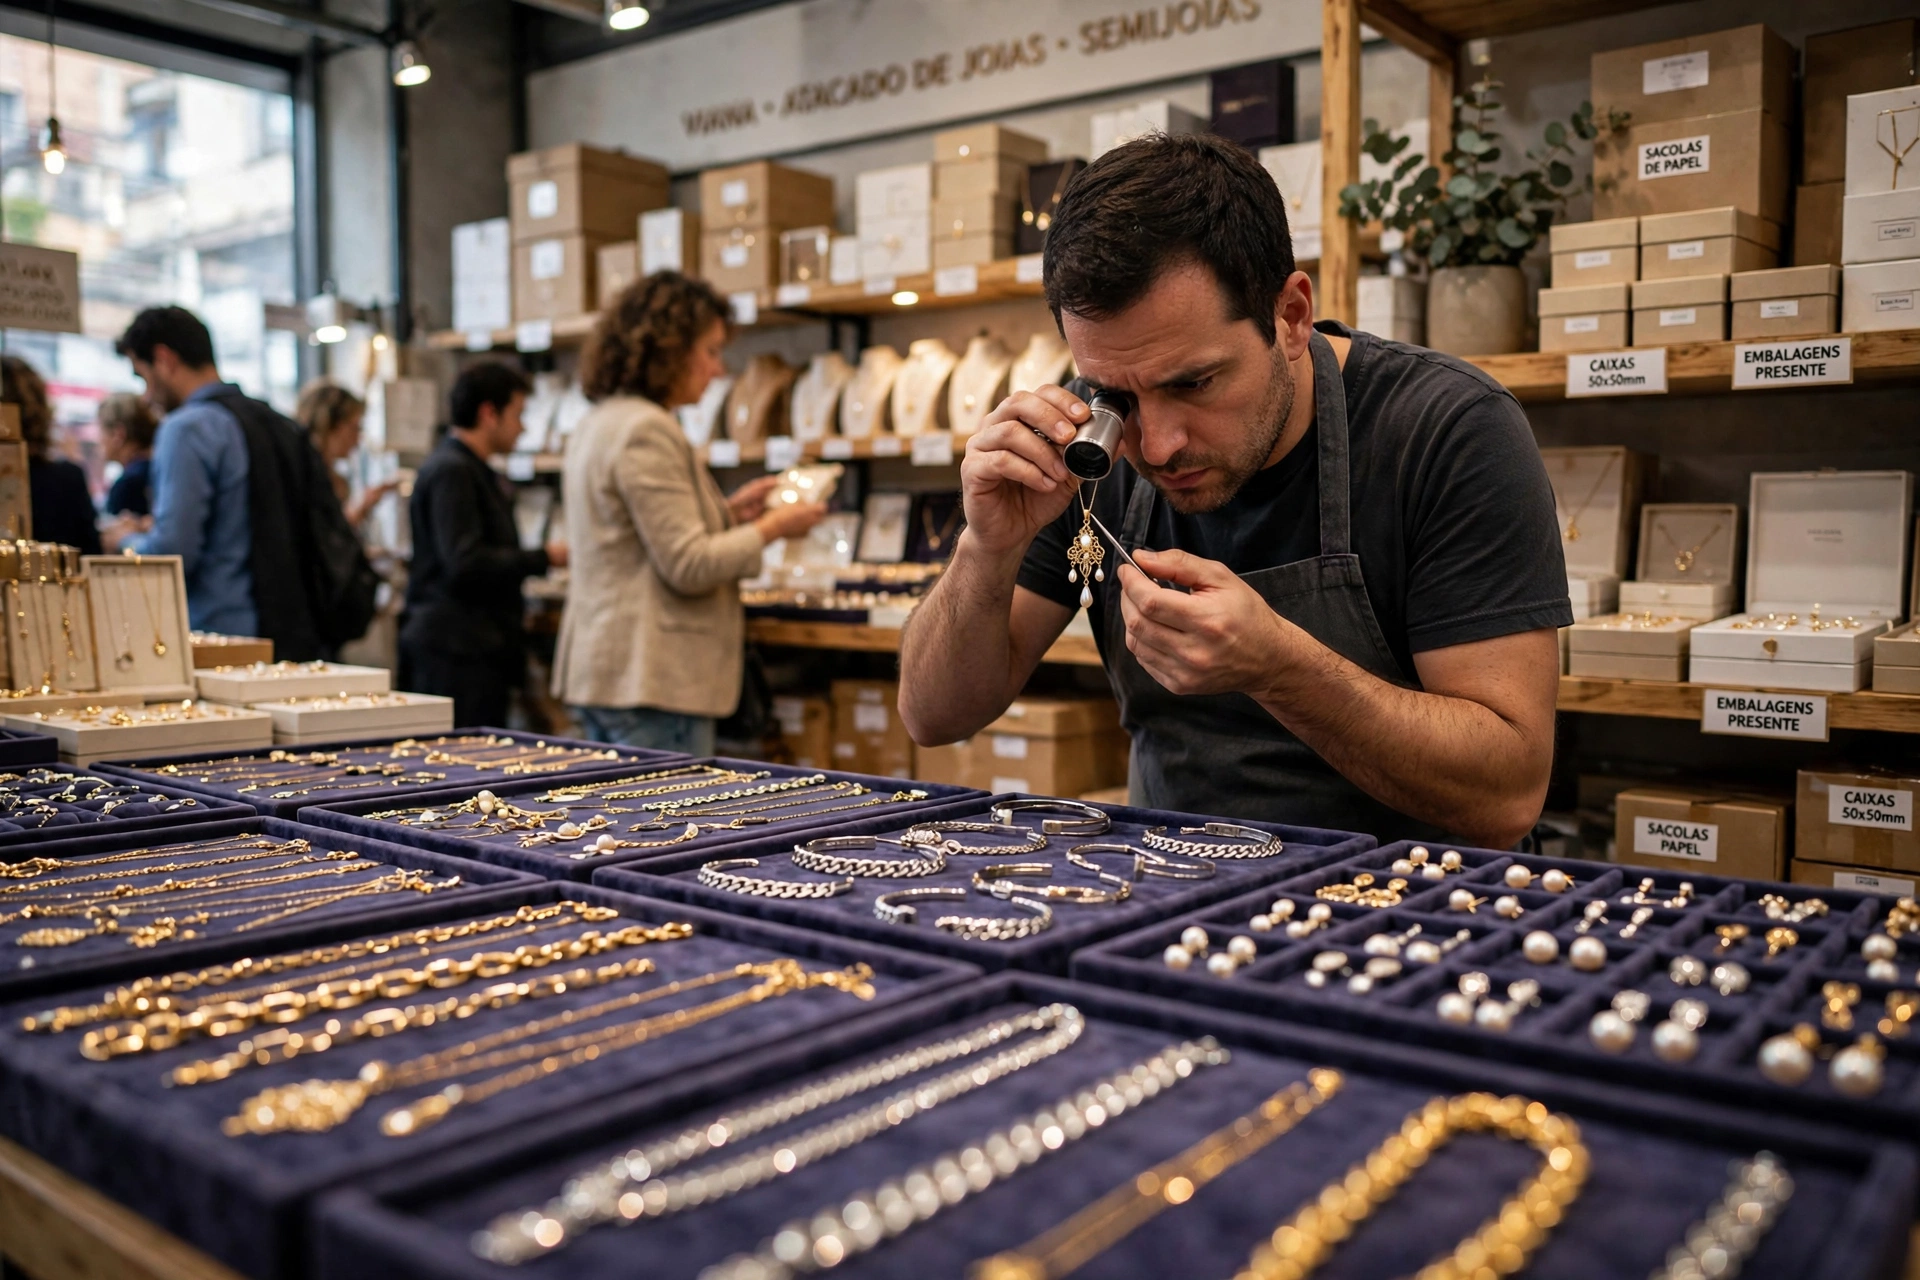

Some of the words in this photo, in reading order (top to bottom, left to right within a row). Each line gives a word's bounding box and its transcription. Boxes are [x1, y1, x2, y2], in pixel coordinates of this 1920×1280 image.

[914, 53, 953, 87] DE
[960, 33, 1047, 82] JOIAS
[1079, 0, 1262, 56] SEMIJOIAS
[1645, 140, 1702, 160] SACOLAS
[1645, 163, 1661, 175] DE
[1666, 157, 1702, 173] PAPEL
[1744, 345, 1840, 364] EMBALAGENS
[1590, 357, 1635, 372] CAIXAS
[1755, 363, 1826, 380] PRESENTE
[1588, 374, 1646, 388] 50x50mm
[1717, 697, 1814, 715] EMBALAGENS
[1728, 714, 1800, 732] PRESENTE
[1844, 791, 1895, 807] CAIXAS
[1842, 807, 1905, 824] 50x50mm
[1648, 823, 1709, 842] SACOLAS
[1661, 840, 1701, 856] PAPEL
